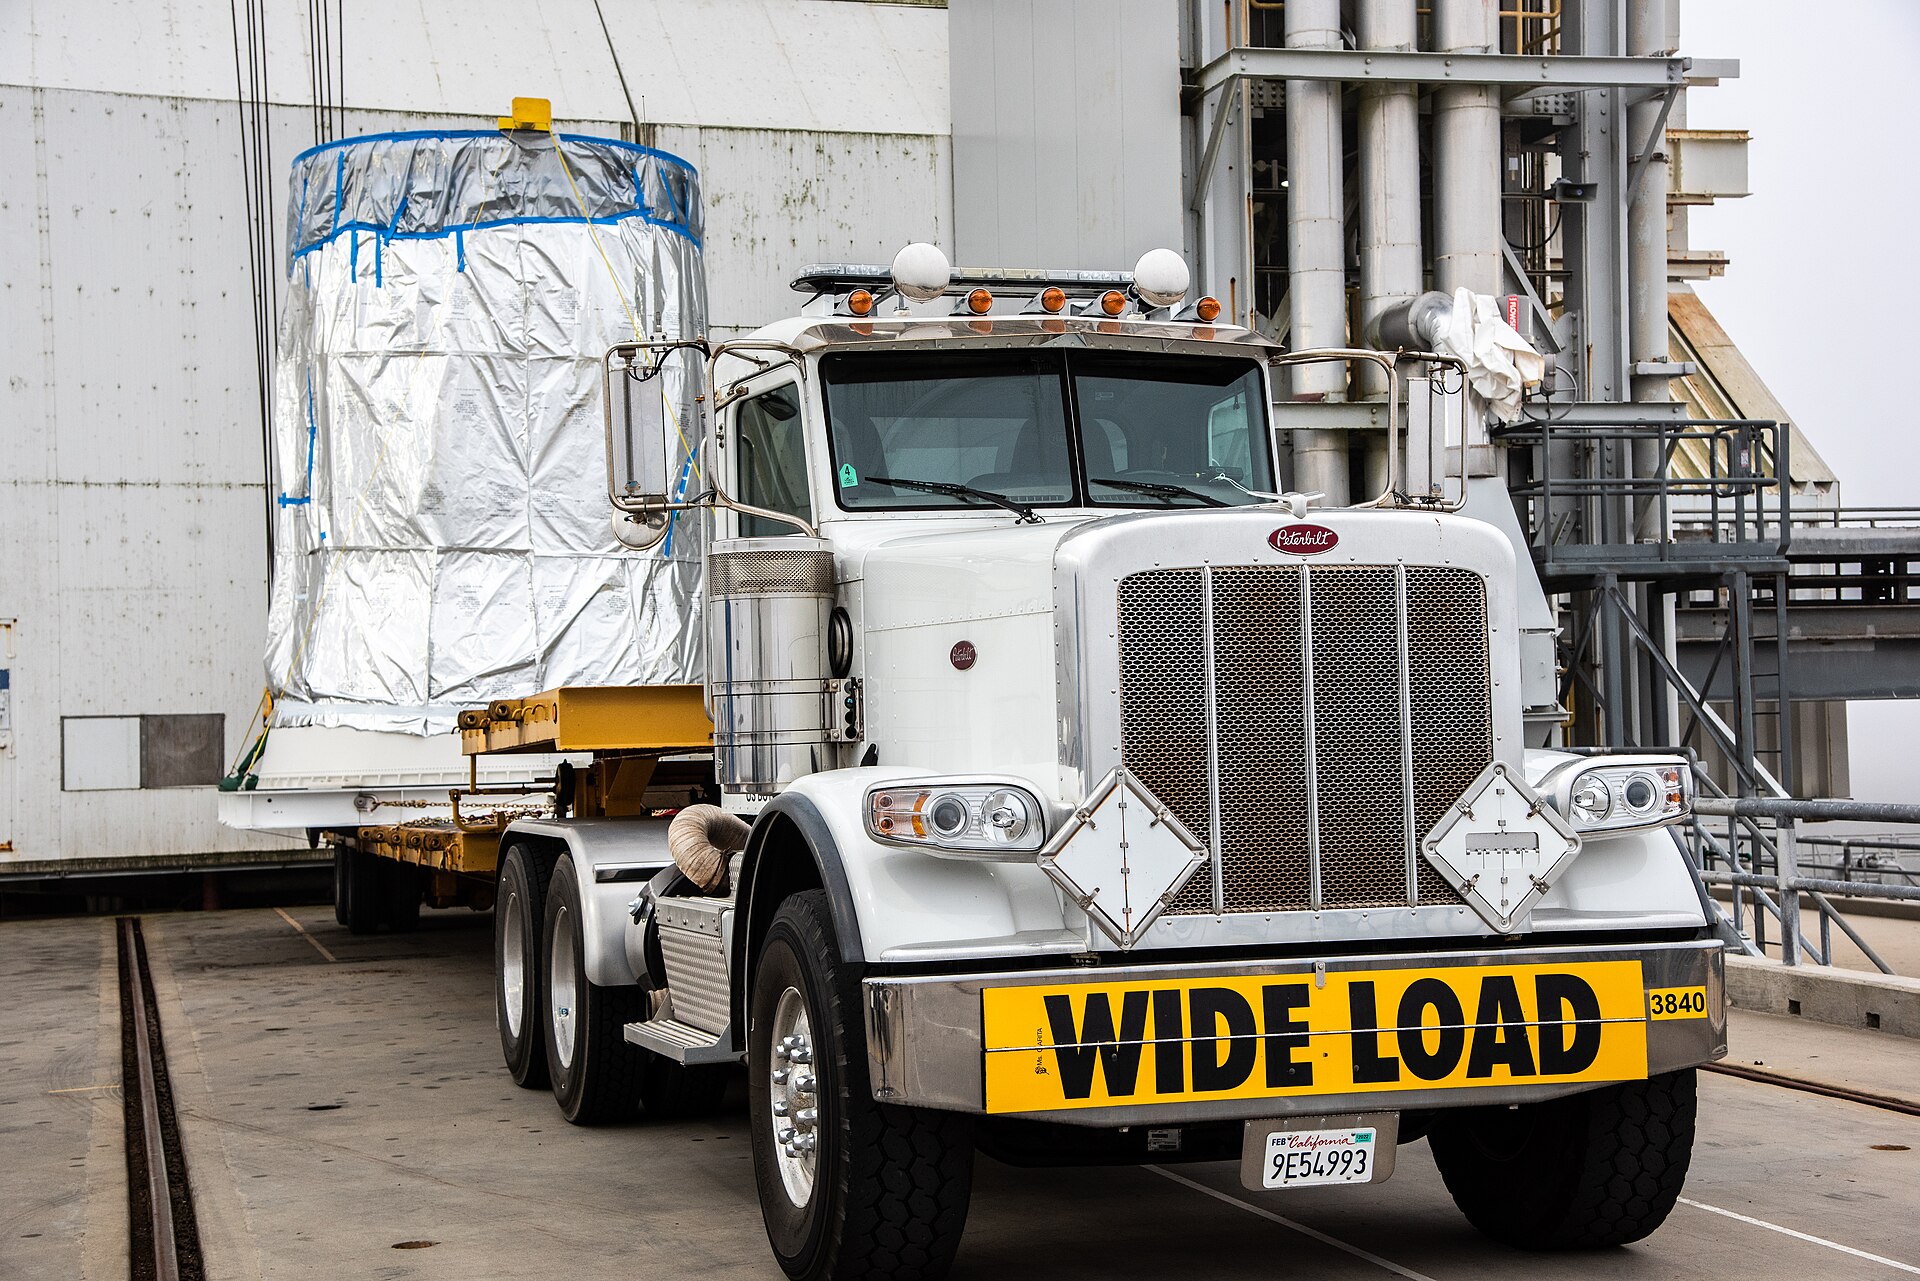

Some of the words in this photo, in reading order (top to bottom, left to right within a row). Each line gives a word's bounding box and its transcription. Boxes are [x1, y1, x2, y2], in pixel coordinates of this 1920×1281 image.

[845, 465, 850, 476] 4
[1277, 529, 1333, 547] Peterbilt
[953, 647, 974, 663] Peterbilt
[1651, 991, 1705, 1015] 3840
[1043, 984, 1313, 1100] WIDE
[1349, 974, 1601, 1085] LOAD
[1272, 1138, 1286, 1146] FEB
[1288, 1135, 1355, 1151] California
[1270, 1149, 1367, 1180] 9E54993
